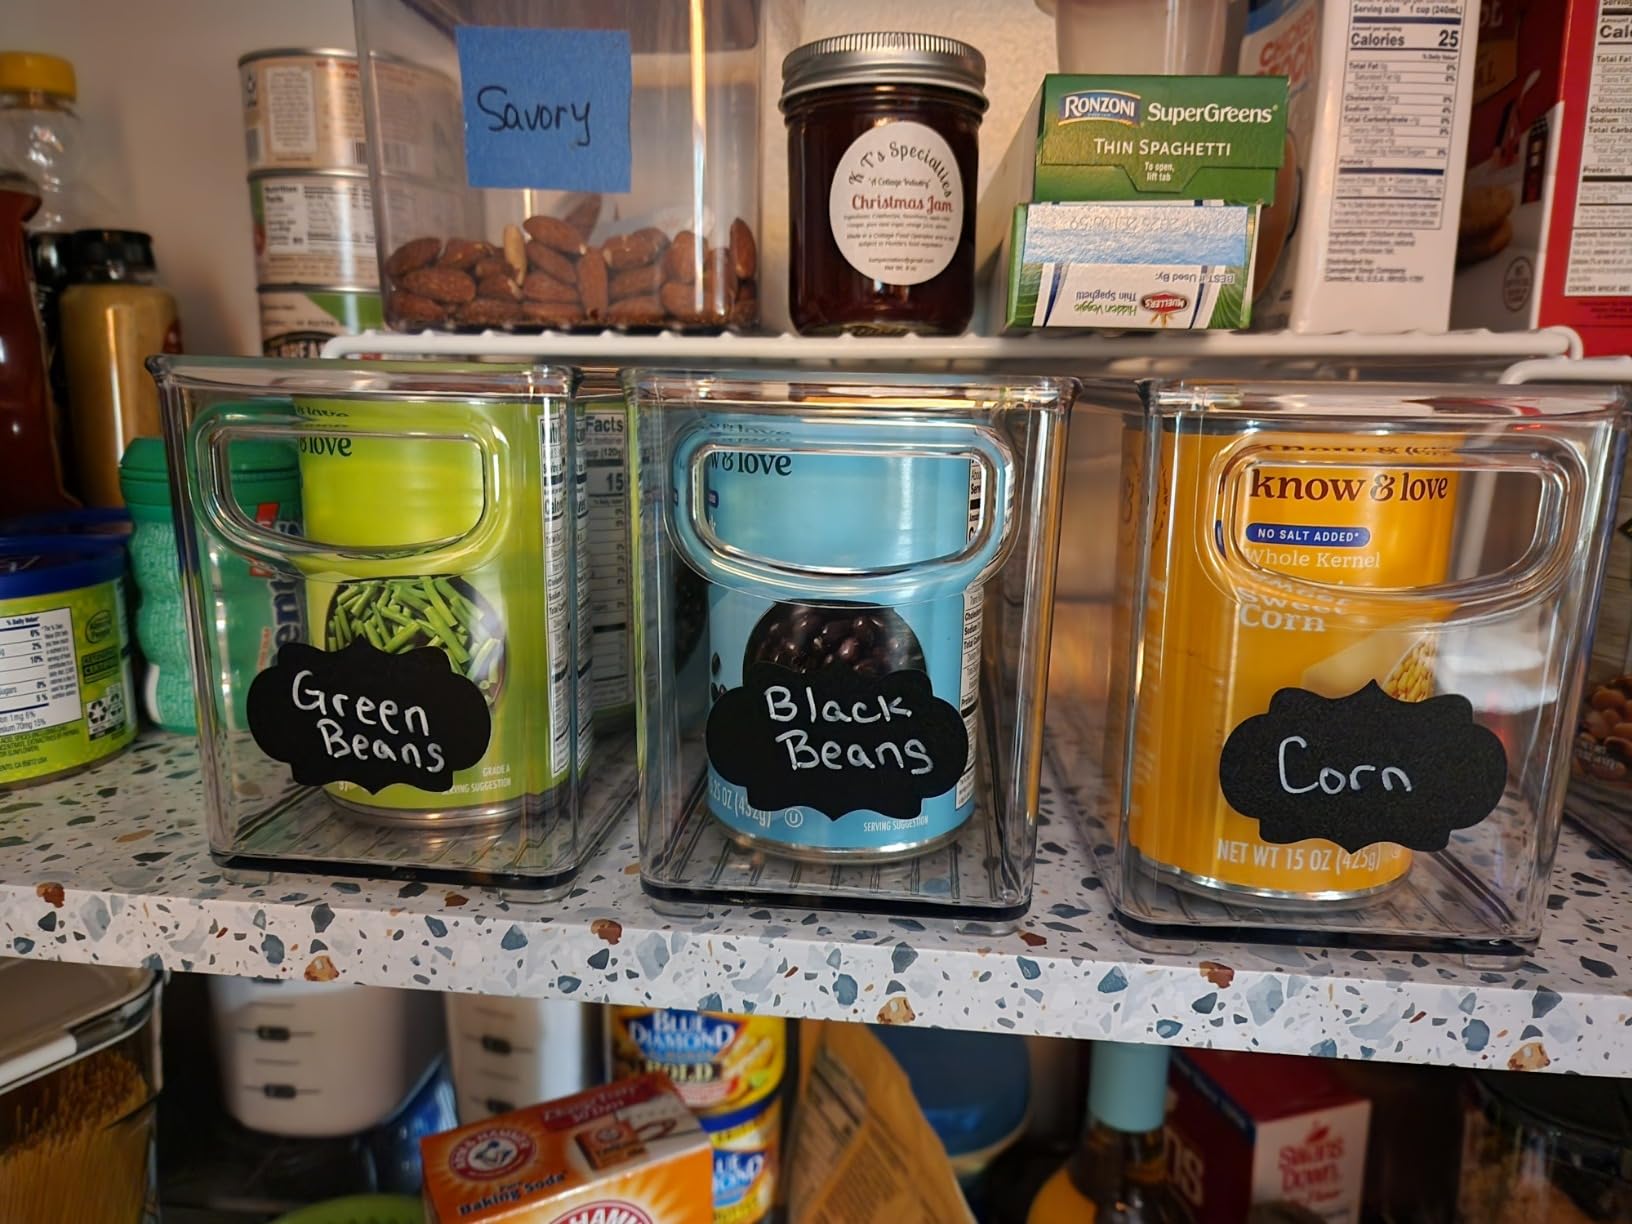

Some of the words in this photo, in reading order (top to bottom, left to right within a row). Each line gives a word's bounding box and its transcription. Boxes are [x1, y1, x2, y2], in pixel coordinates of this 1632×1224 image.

[1353, 5, 1382, 15] Serving
[1384, 6, 1400, 14] size
[1416, 6, 1430, 15] cup
[1351, 33, 1405, 47] Calories
[1438, 29, 1459, 48] 25
[477, 85, 591, 147] Savory
[1064, 95, 1136, 118] RONZONI
[1094, 138, 1134, 155] THIN
[1139, 139, 1231, 157] SPAGHETTI
[889, 141, 952, 198] Specialties
[1144, 161, 1154, 171] To
[1146, 172, 1158, 182] lift
[1158, 172, 1171, 182] tab
[851, 194, 925, 212] Christmas
[926, 195, 953, 215] Jam
[1172, 274, 1197, 283] Used
[1208, 274, 1235, 284] BEST
[1075, 290, 1117, 303] Spaghetti
[1119, 291, 1137, 301] Thin
[1144, 296, 1187, 309] MUELLER'S
[1103, 304, 1137, 316] Hidden
[586, 415, 624, 433] Facts
[737, 451, 792, 477] love
[606, 472, 624, 492] 15
[1249, 468, 1365, 502] know
[1370, 473, 1395, 502] &
[1399, 472, 1449, 501] love
[1257, 528, 1274, 539] NO
[1279, 529, 1310, 542] SALT
[1316, 551, 1381, 569] Kernel
[1239, 603, 1327, 633] Corn
[291, 669, 430, 737] Green
[764, 684, 913, 723] Black
[316, 718, 446, 773] Beans
[775, 729, 935, 776] Beans
[482, 765, 505, 778] GRADE
[1277, 735, 1413, 795] Corn
[471, 778, 512, 793] SUGGESTION
[864, 820, 891, 833] SERVING
[1217, 838, 1250, 864] NET
[1252, 843, 1280, 870] WT
[1285, 847, 1302, 872] 15
[1309, 849, 1331, 872] OZ
[1335, 849, 1382, 875] (425g)
[629, 1020, 736, 1050] DIAMOND
[457, 1189, 522, 1216] Baking
[524, 1170, 566, 1194] Soda
